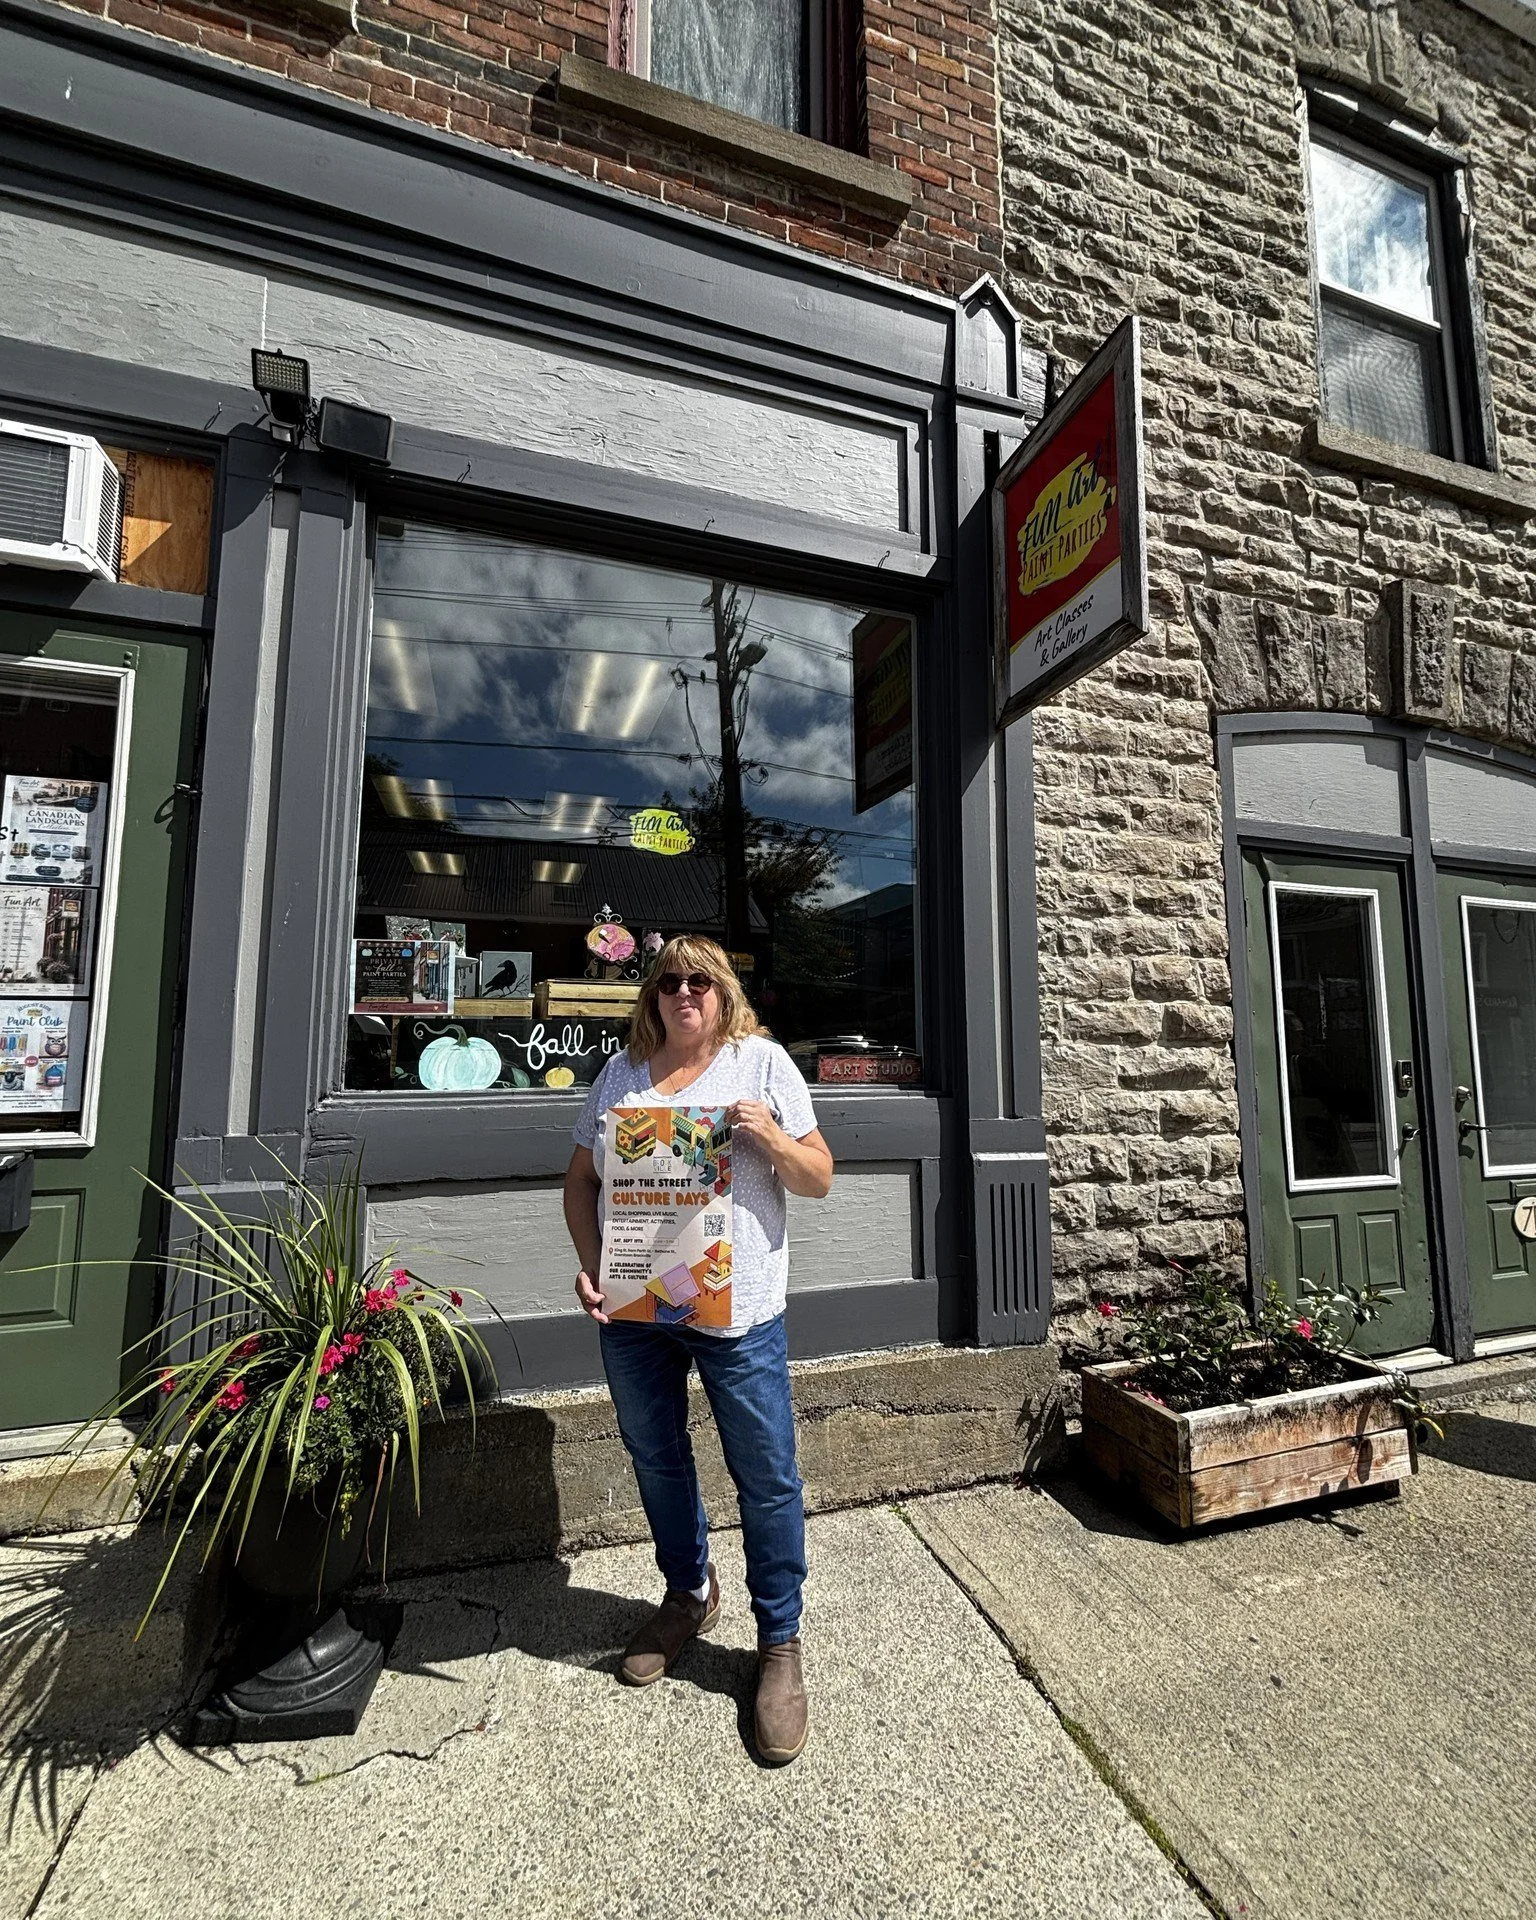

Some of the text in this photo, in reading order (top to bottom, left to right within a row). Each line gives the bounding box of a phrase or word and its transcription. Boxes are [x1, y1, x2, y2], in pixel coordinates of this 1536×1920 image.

[1022, 509, 1103, 586] PAINT PARTIES
[1034, 594, 1094, 652] Art Classes
[1039, 623, 1088, 667] & Gallery
[28, 809, 81, 819] CANADIAN
[25, 816, 85, 827] LANDSCAPES
[659, 835, 687, 850] PARTIES
[3, 895, 43, 907] Fun Art
[373, 962, 395, 974] fall
[7, 1015, 63, 1026] Paint Club
[498, 1023, 624, 1070] fall in
[831, 1063, 913, 1076] ART STUDIO
[612, 1178, 692, 1187] SHOP THE STREET
[612, 1191, 710, 1206] CULTURE DAYS
[1522, 1205, 1536, 1232] 7
